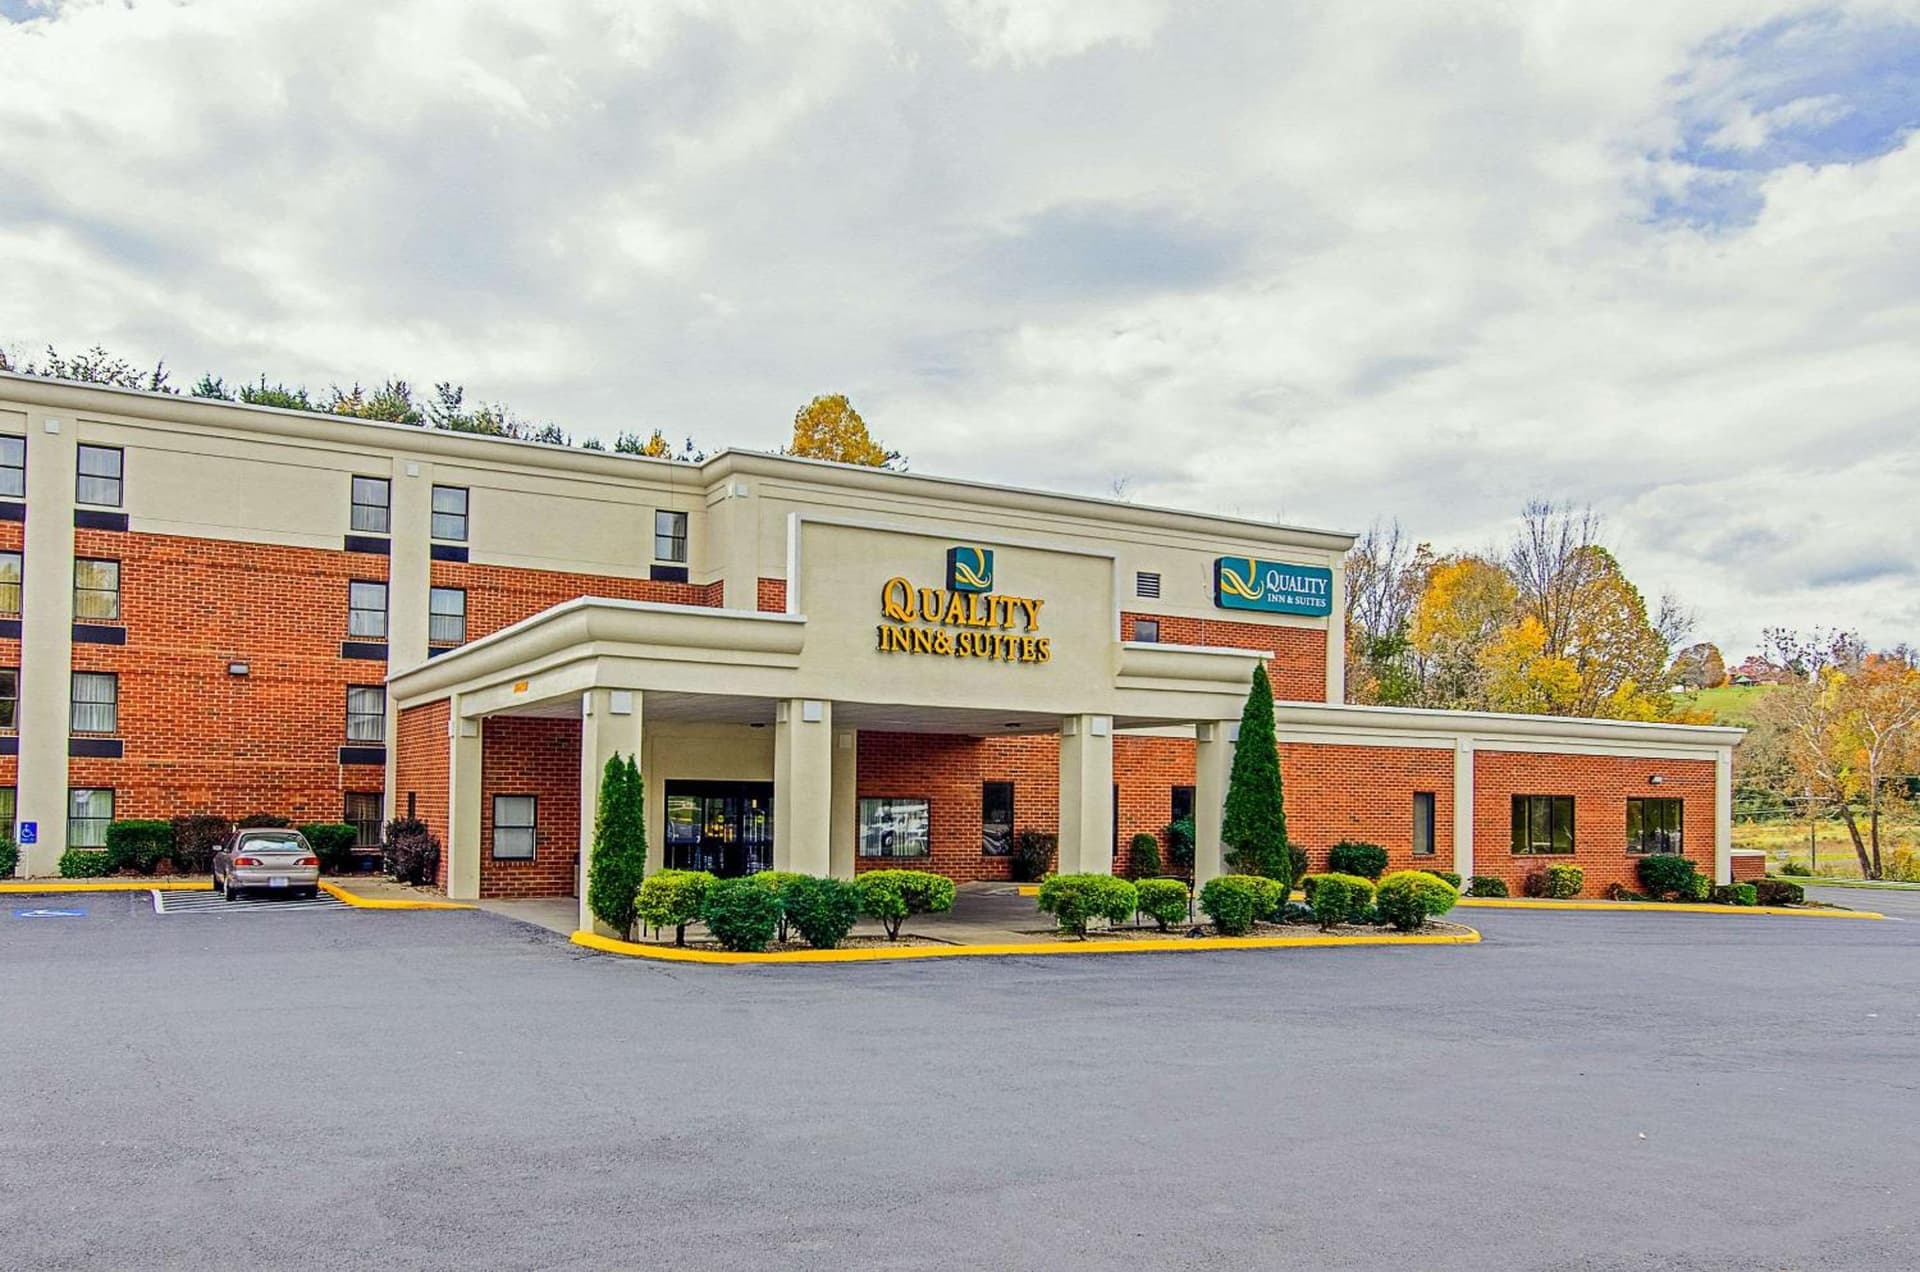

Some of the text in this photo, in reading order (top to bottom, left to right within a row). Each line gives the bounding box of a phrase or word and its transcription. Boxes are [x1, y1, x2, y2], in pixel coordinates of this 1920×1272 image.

[1266, 570, 1328, 594] QUALITY
[882, 576, 1044, 632] QUALITY
[1267, 593, 1326, 607] INN & SUITES
